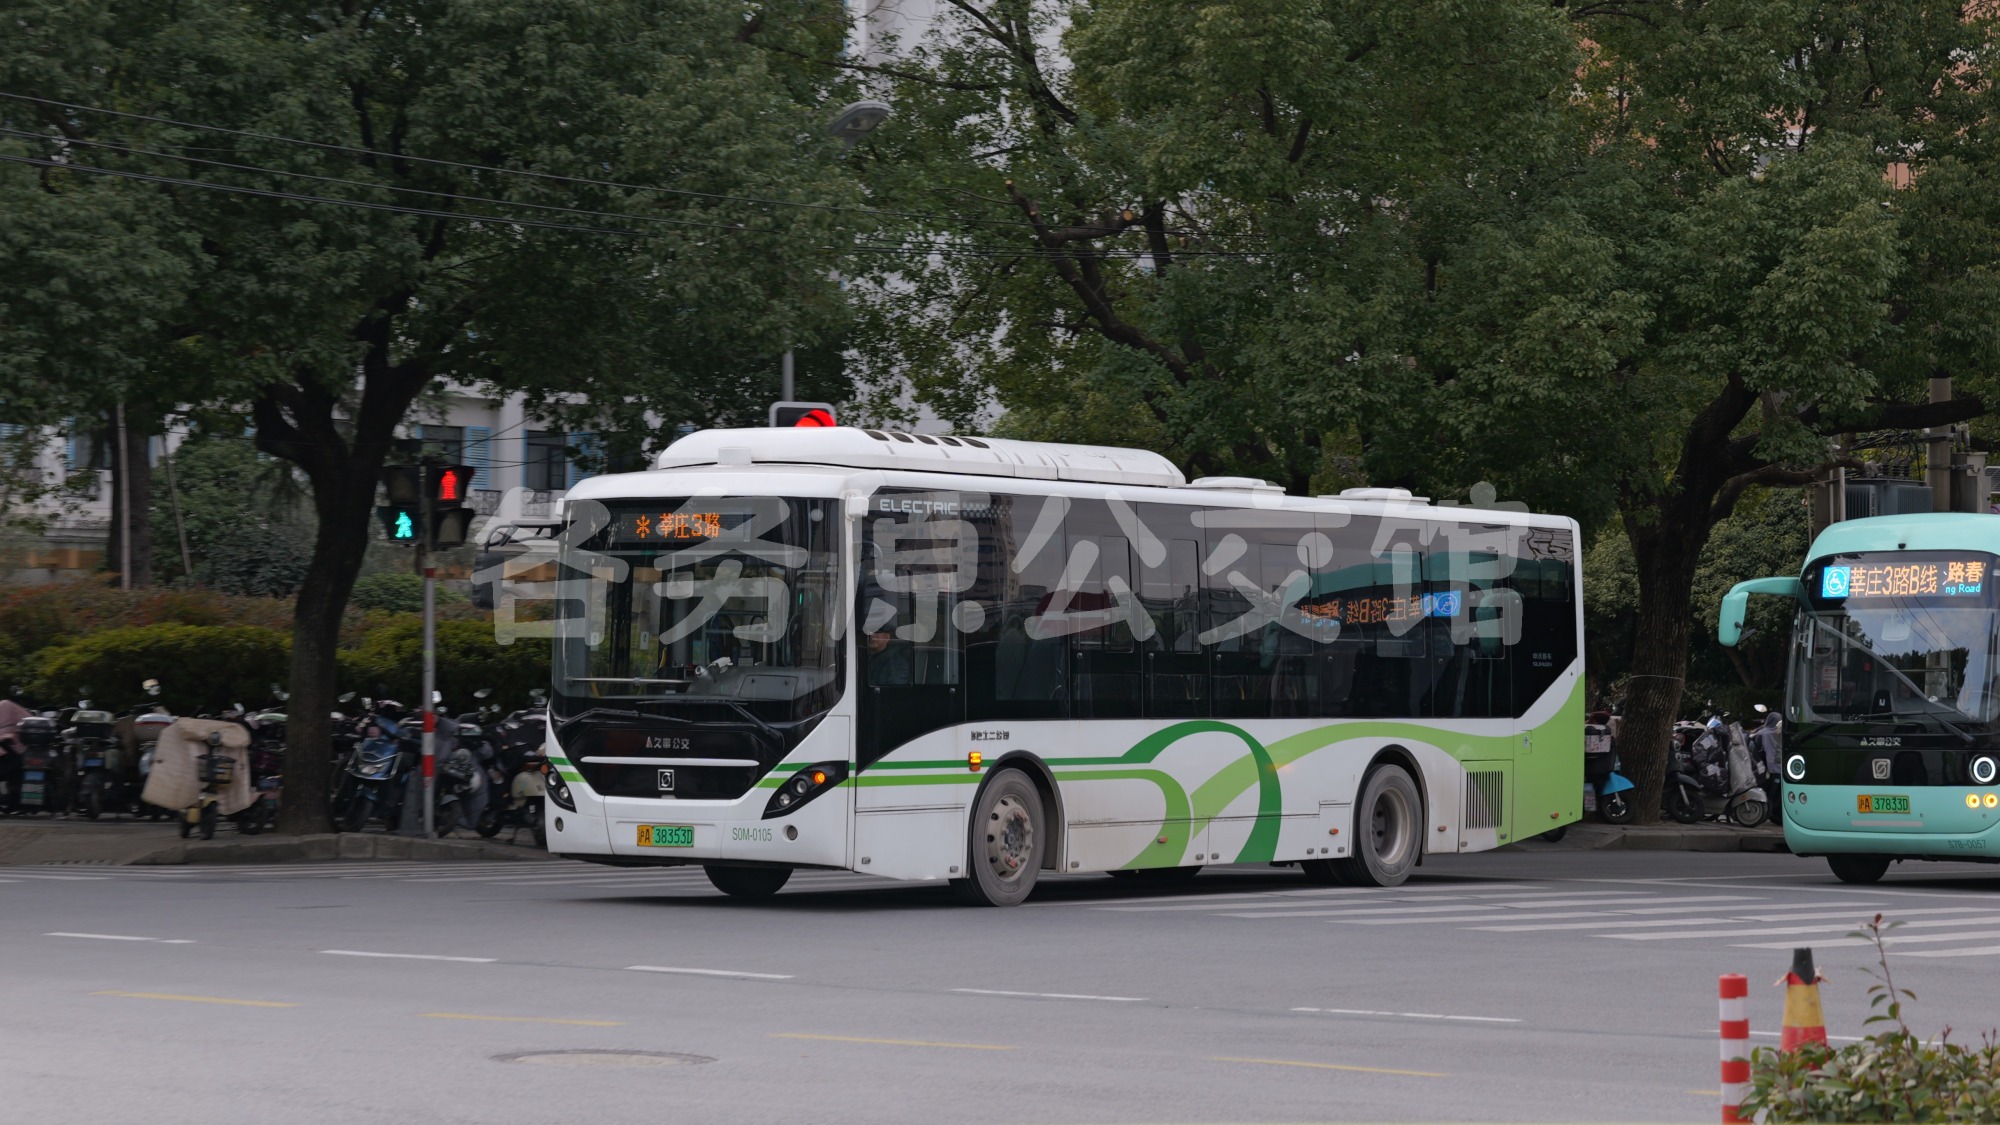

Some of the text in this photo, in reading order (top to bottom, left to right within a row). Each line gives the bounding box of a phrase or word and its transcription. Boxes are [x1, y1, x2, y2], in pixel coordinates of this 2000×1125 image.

[880, 499, 959, 515] ELECTRIC
[660, 513, 720, 538] 莘庄3路
[1850, 561, 1986, 597] 莘庄3路B线 路春
[1958, 583, 1981, 593] Road
